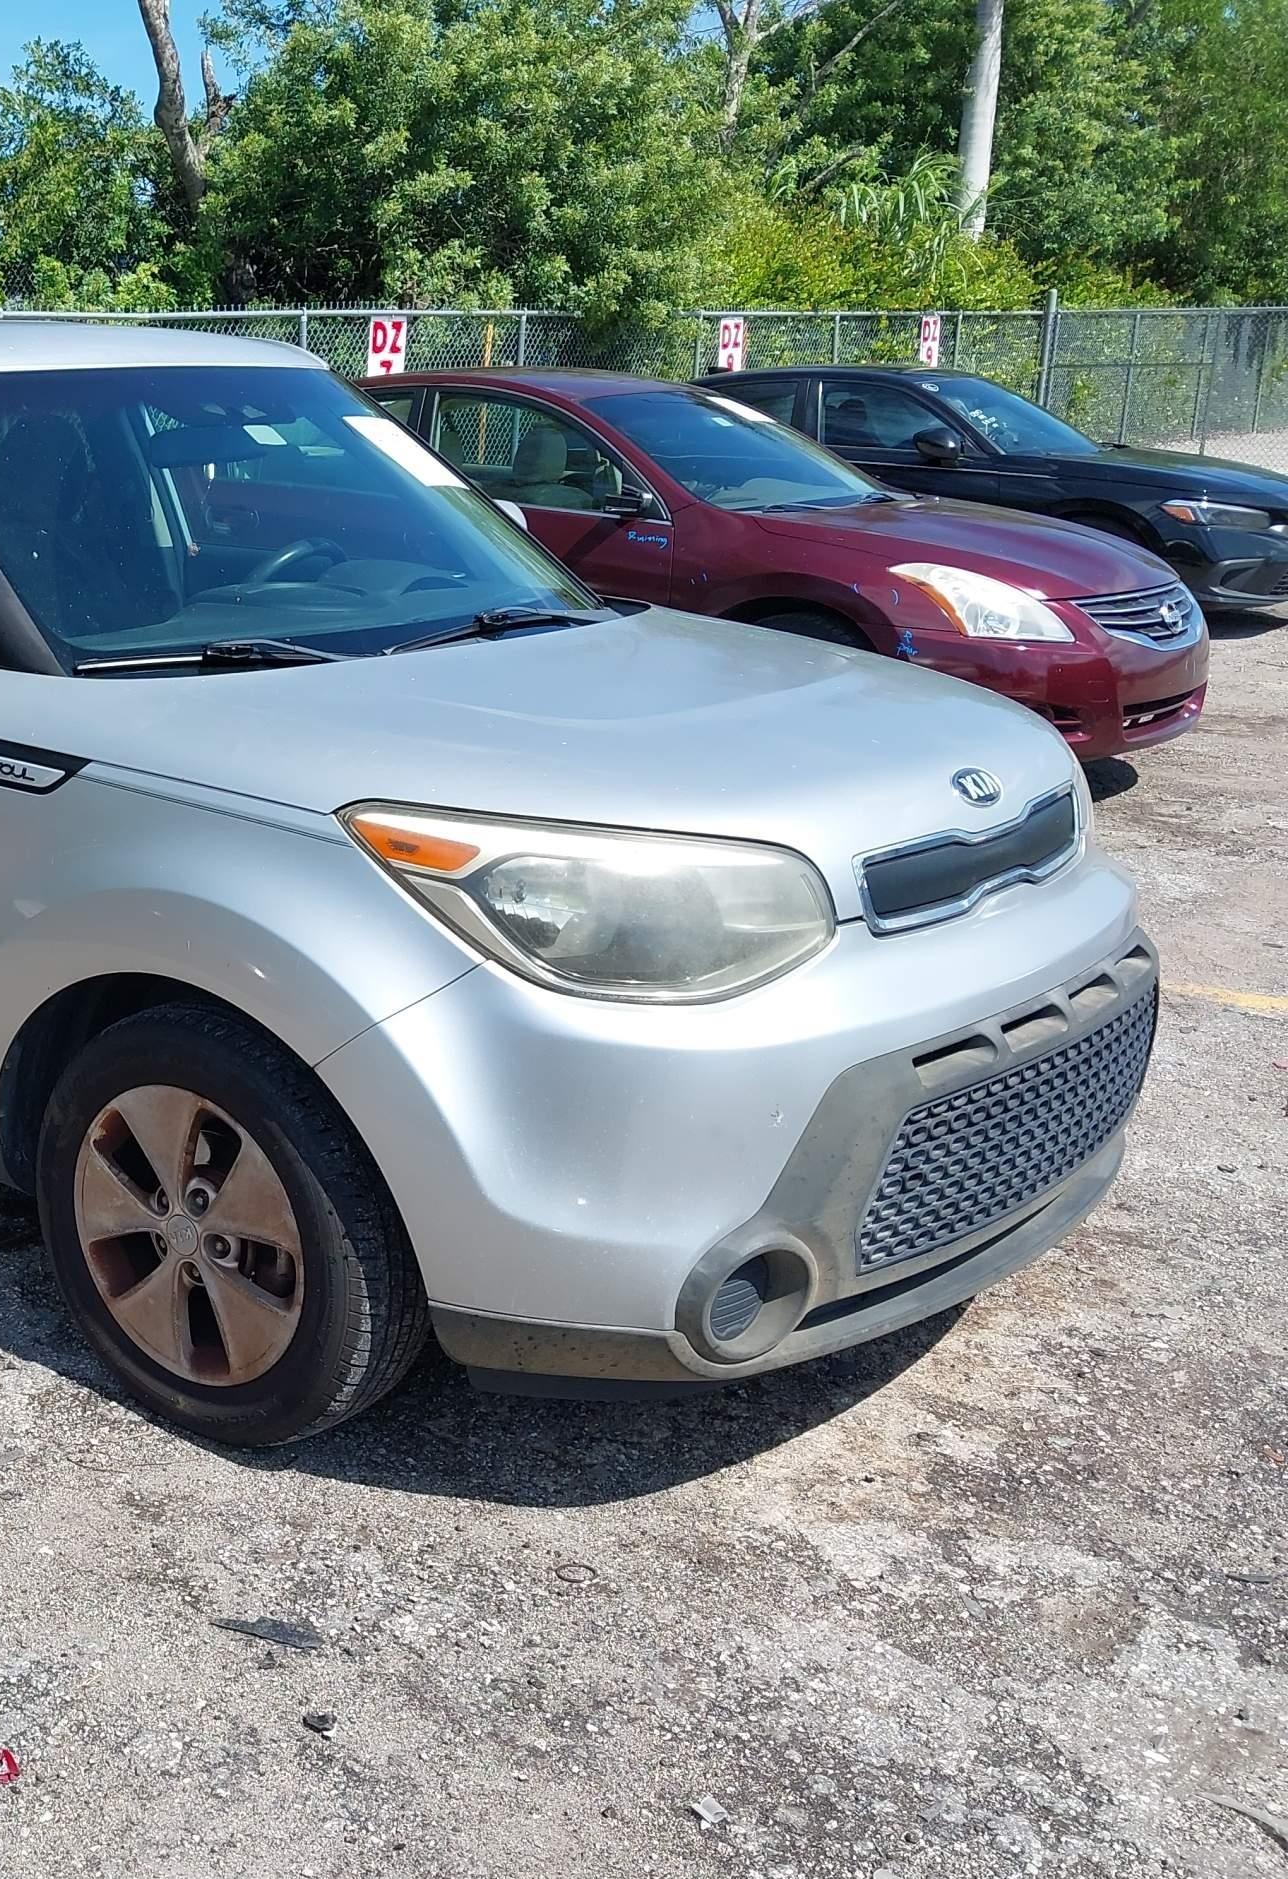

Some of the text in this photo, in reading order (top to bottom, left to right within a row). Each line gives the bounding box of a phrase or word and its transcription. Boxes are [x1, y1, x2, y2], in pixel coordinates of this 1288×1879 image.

[372, 321, 403, 354] DZ
[722, 322, 742, 350] DZ
[923, 319, 938, 342] DZ
